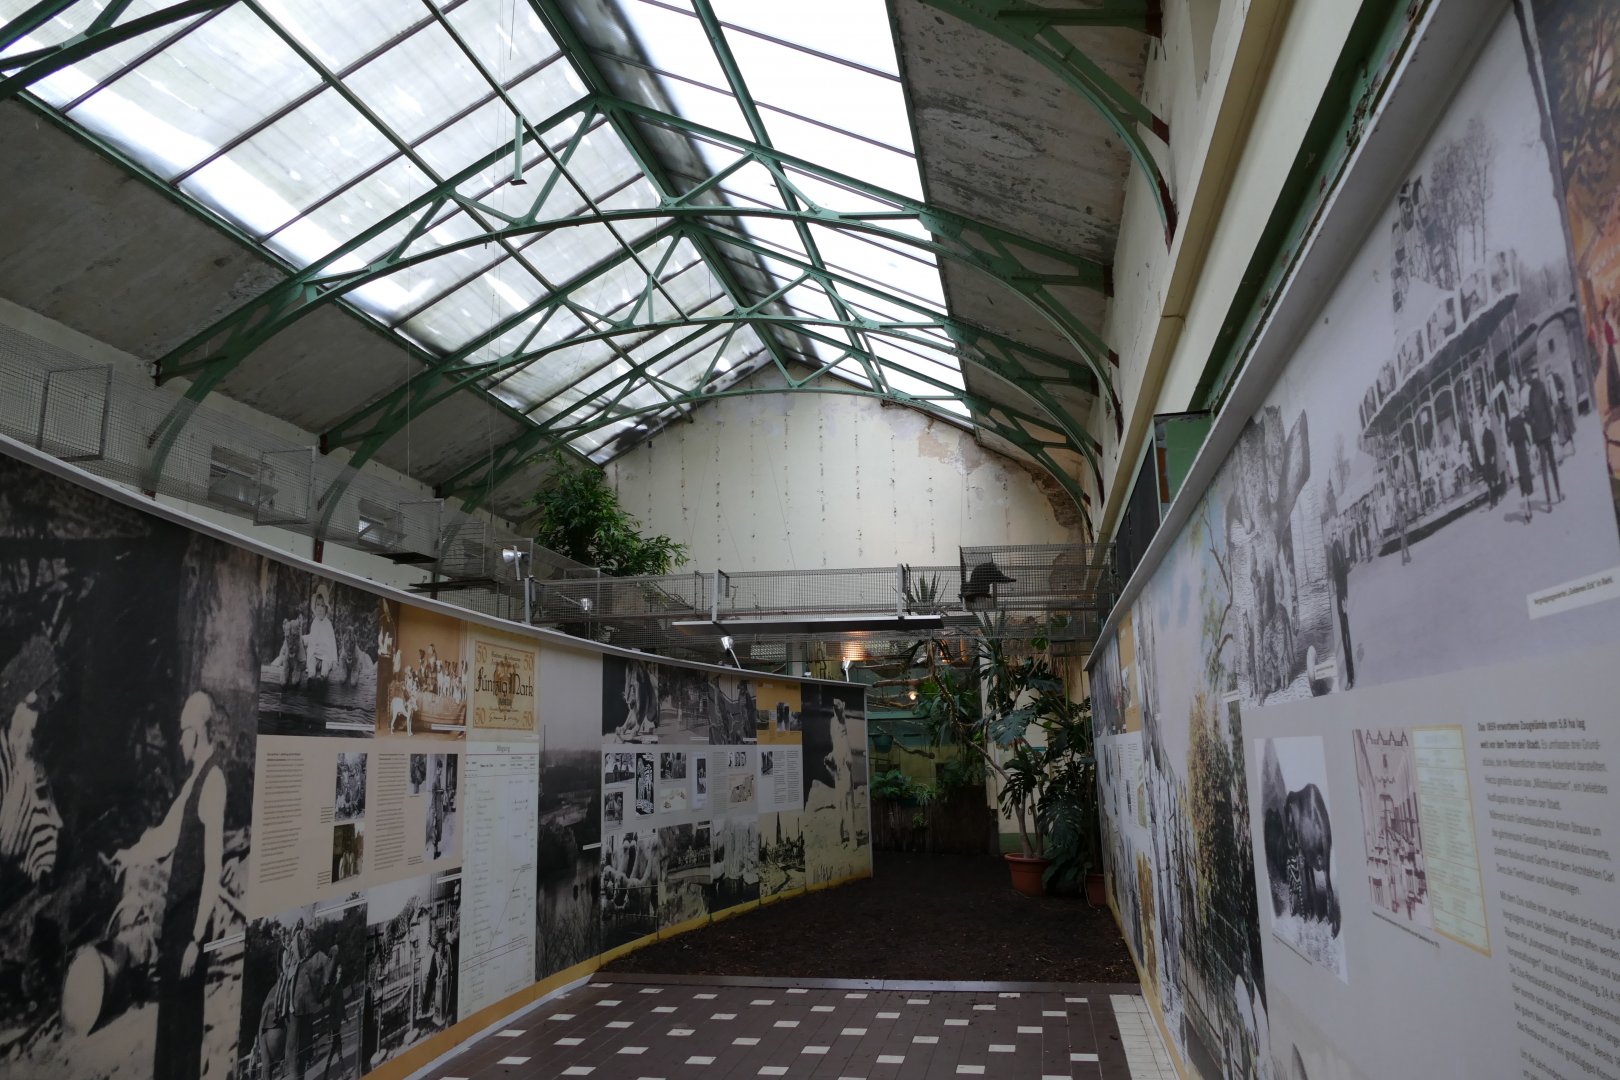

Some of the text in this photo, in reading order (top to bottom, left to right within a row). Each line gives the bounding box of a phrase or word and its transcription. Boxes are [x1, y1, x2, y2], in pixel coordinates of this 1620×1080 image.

[477, 645, 488, 663] 50
[509, 672, 534, 696] Mark
[475, 707, 486, 725] 50
